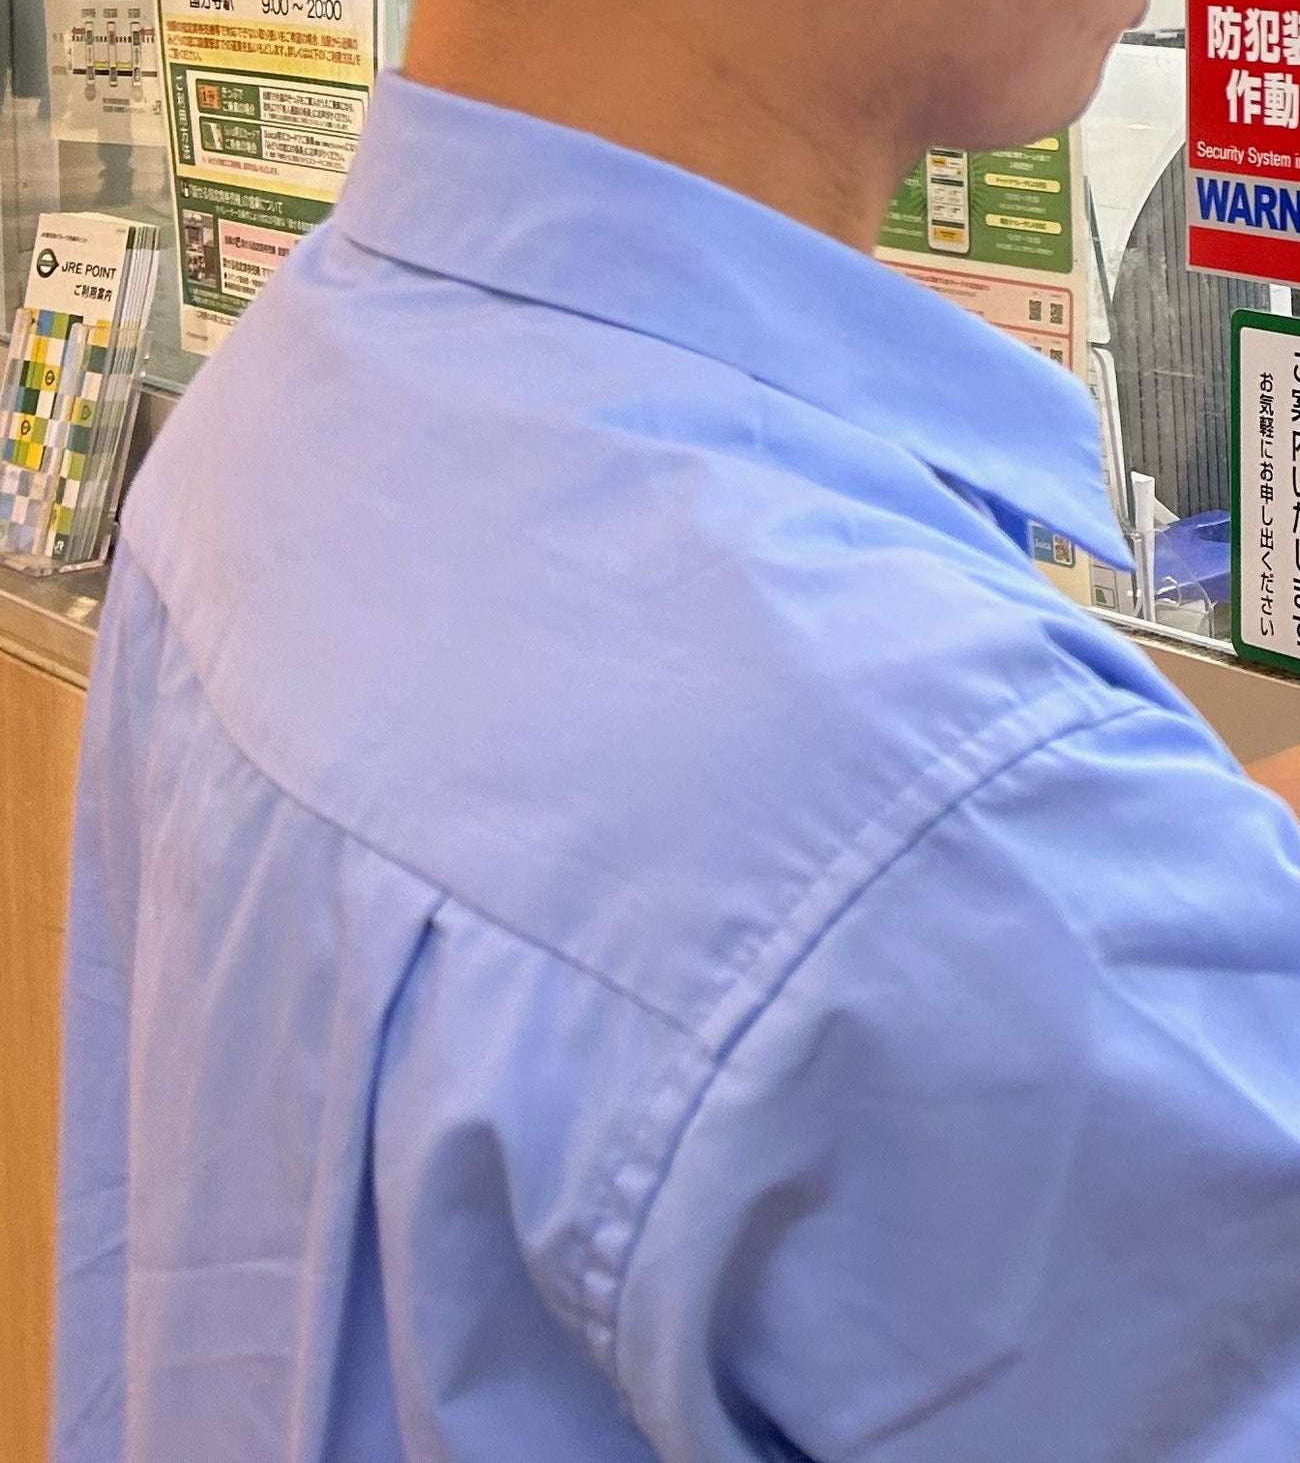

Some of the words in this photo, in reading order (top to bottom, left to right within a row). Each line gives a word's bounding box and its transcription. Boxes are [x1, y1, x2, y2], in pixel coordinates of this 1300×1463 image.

[1197, 141, 1245, 166] Security
[1247, 147, 1292, 170] System
[61, 260, 83, 276] JRE
[85, 263, 118, 281] POINT
[1258, 371, 1275, 637] お気軽にお申し出ください
